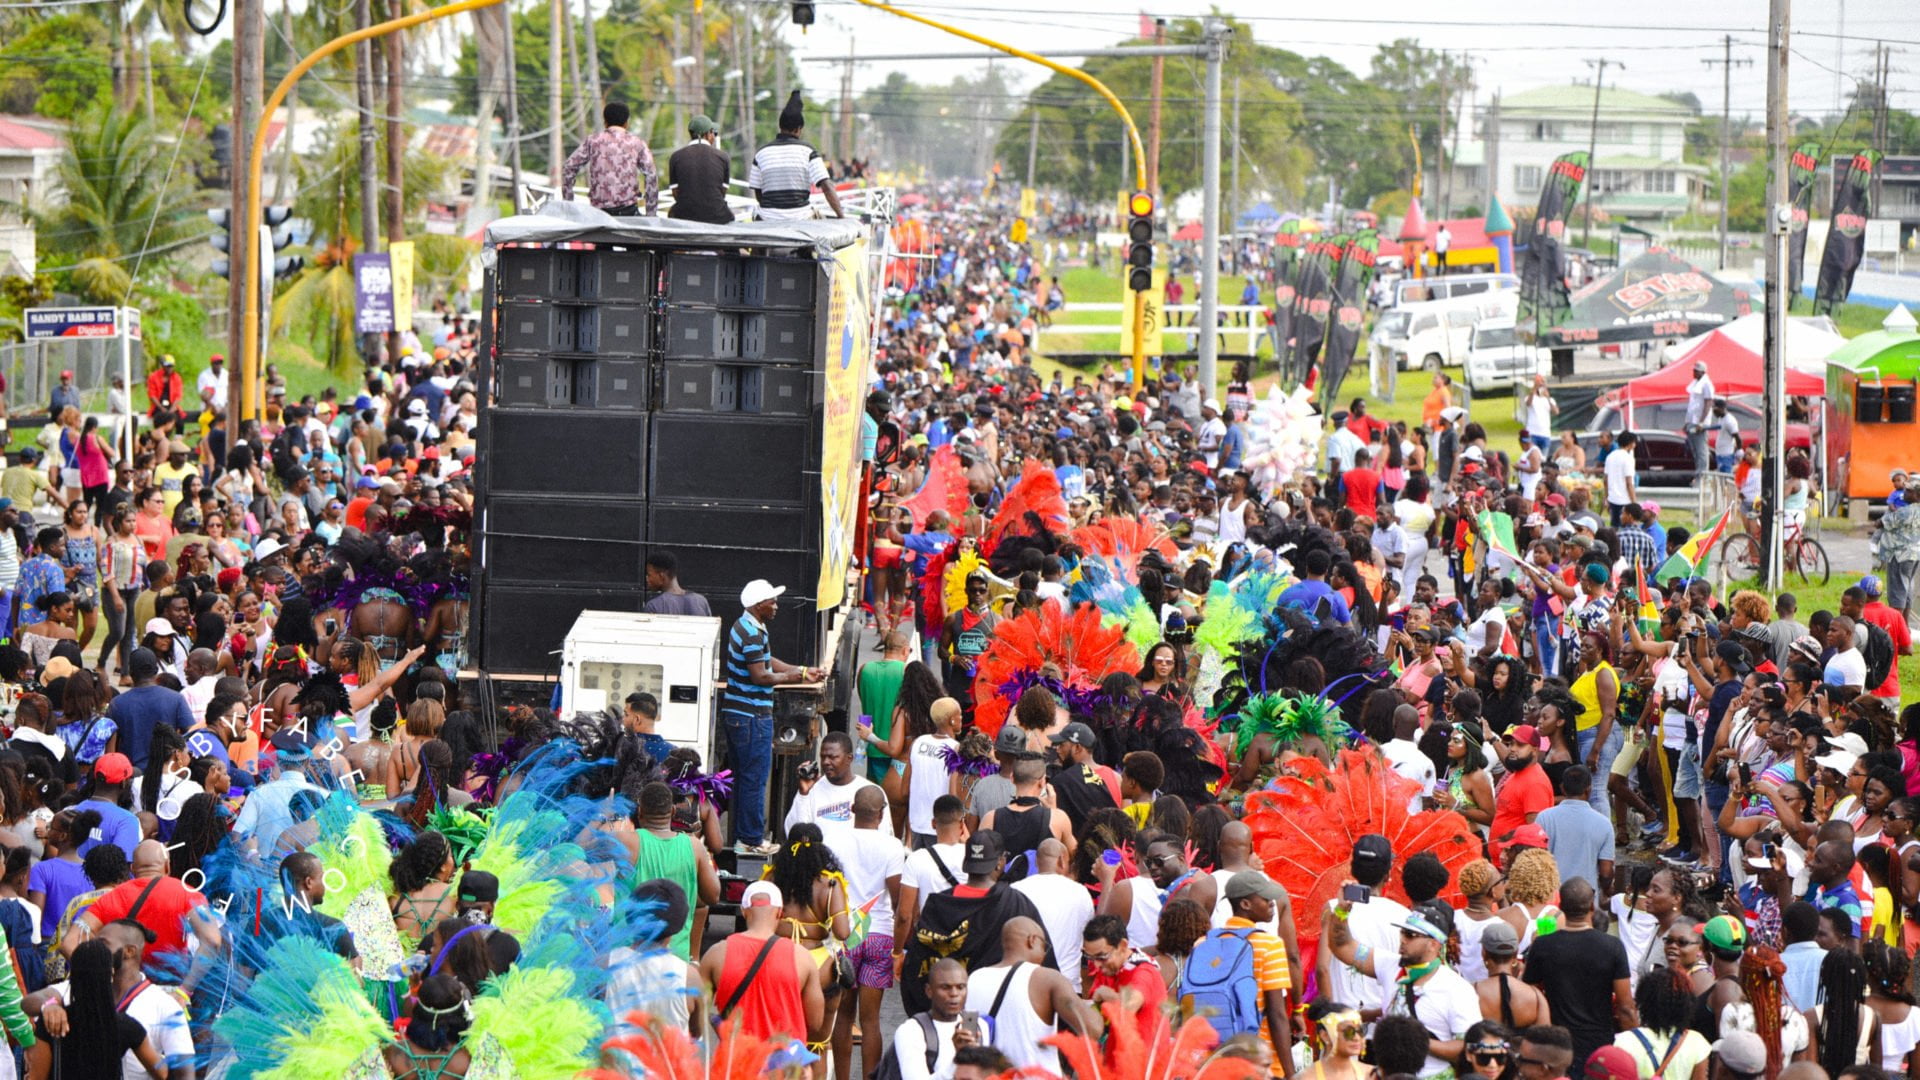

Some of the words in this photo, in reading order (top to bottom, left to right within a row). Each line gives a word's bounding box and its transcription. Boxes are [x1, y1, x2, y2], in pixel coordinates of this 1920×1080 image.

[1615, 271, 1714, 309] STAG
[31, 313, 65, 323] SANDY
[77, 325, 110, 336] Digicel
